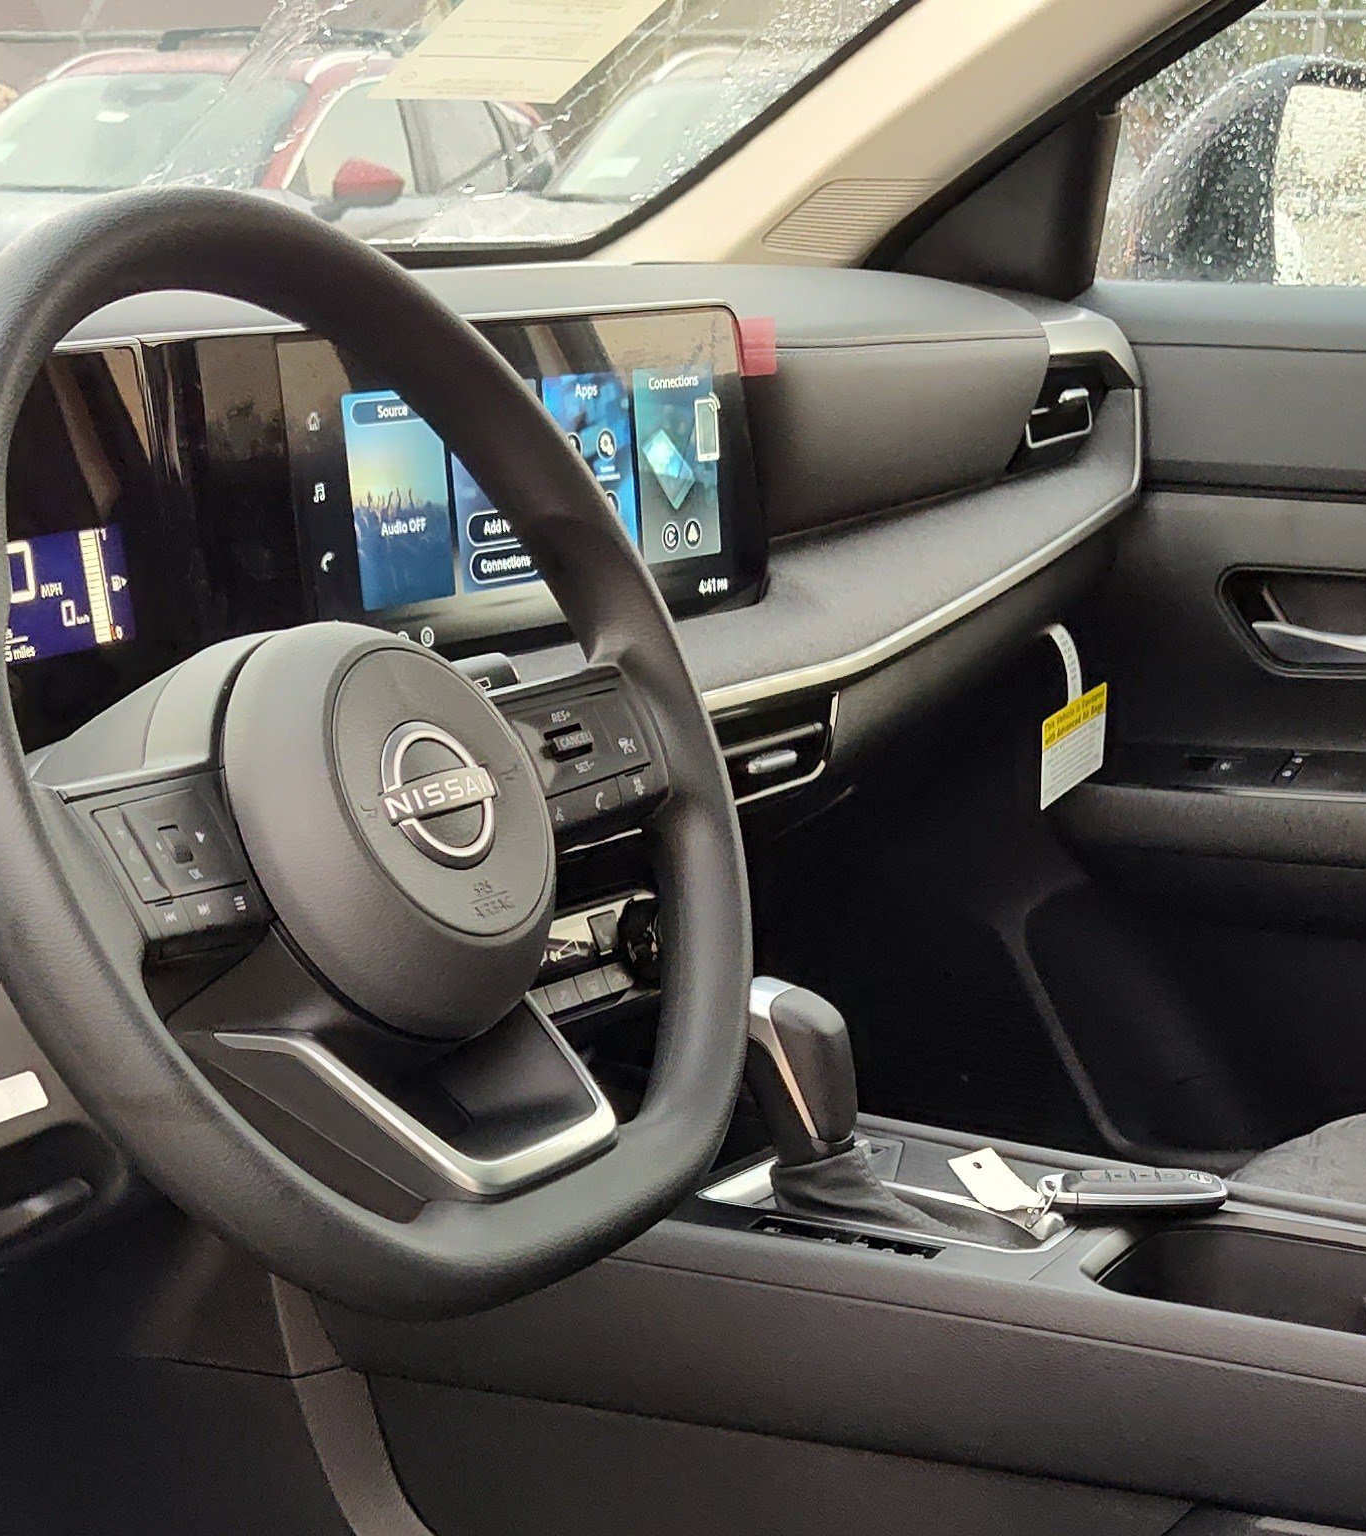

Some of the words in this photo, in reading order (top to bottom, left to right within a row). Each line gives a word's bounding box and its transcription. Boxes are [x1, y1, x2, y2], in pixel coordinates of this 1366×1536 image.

[574, 383, 598, 399] Apps
[648, 374, 699, 390] Connections
[377, 404, 408, 419] Source
[381, 519, 408, 537] Audio
[409, 516, 427, 532] OFF
[483, 518, 502, 536] Add
[480, 554, 532, 574] Connections
[39, 581, 64, 599] MPH
[385, 773, 493, 820] NISSAN
